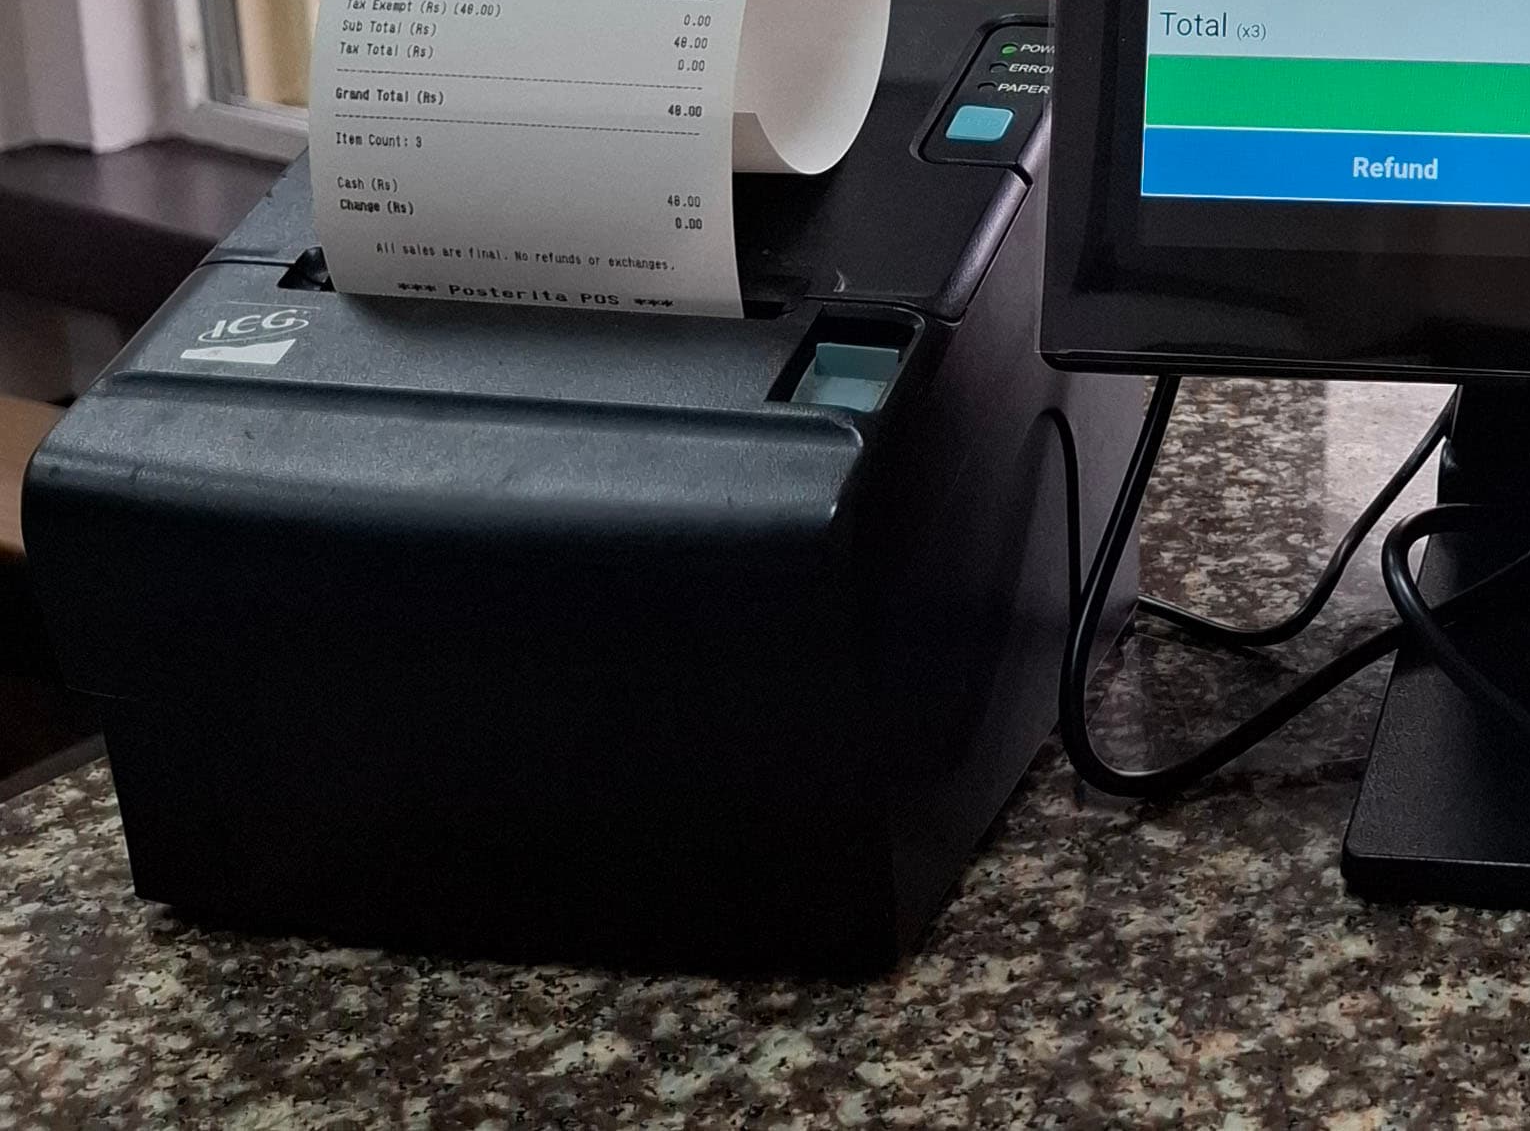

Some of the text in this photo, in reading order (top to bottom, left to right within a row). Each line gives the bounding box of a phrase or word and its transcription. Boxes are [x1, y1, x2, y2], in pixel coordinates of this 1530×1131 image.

[419, 0, 448, 14] (Rs)
[453, 1, 501, 17] (48.00)
[342, 20, 438, 37] Sub Total (Rs)
[683, 14, 711, 27] 0.00
[1160, 11, 1267, 42] Total (x3)
[339, 41, 435, 59] Tax Total (Rs)
[674, 36, 708, 49] 48.00
[1020, 44, 1055, 54] POW
[677, 59, 705, 71] 0.00
[335, 86, 445, 105] Grand Total (Rs)
[997, 83, 1051, 94] PAPER
[668, 104, 703, 117] 48.00
[335, 131, 423, 148] Item Count: 3
[1352, 155, 1439, 181] Refund
[337, 176, 399, 193] Cash (Rs)
[339, 198, 415, 216] Change (Rs)
[667, 195, 701, 208] 48.00
[675, 217, 703, 229] 0.00
[376, 242, 676, 272] All sales are final. No refunds or exchanges.
[448, 284, 568, 304] Posterita
[580, 293, 620, 306] POS
[211, 309, 300, 339] ICG
